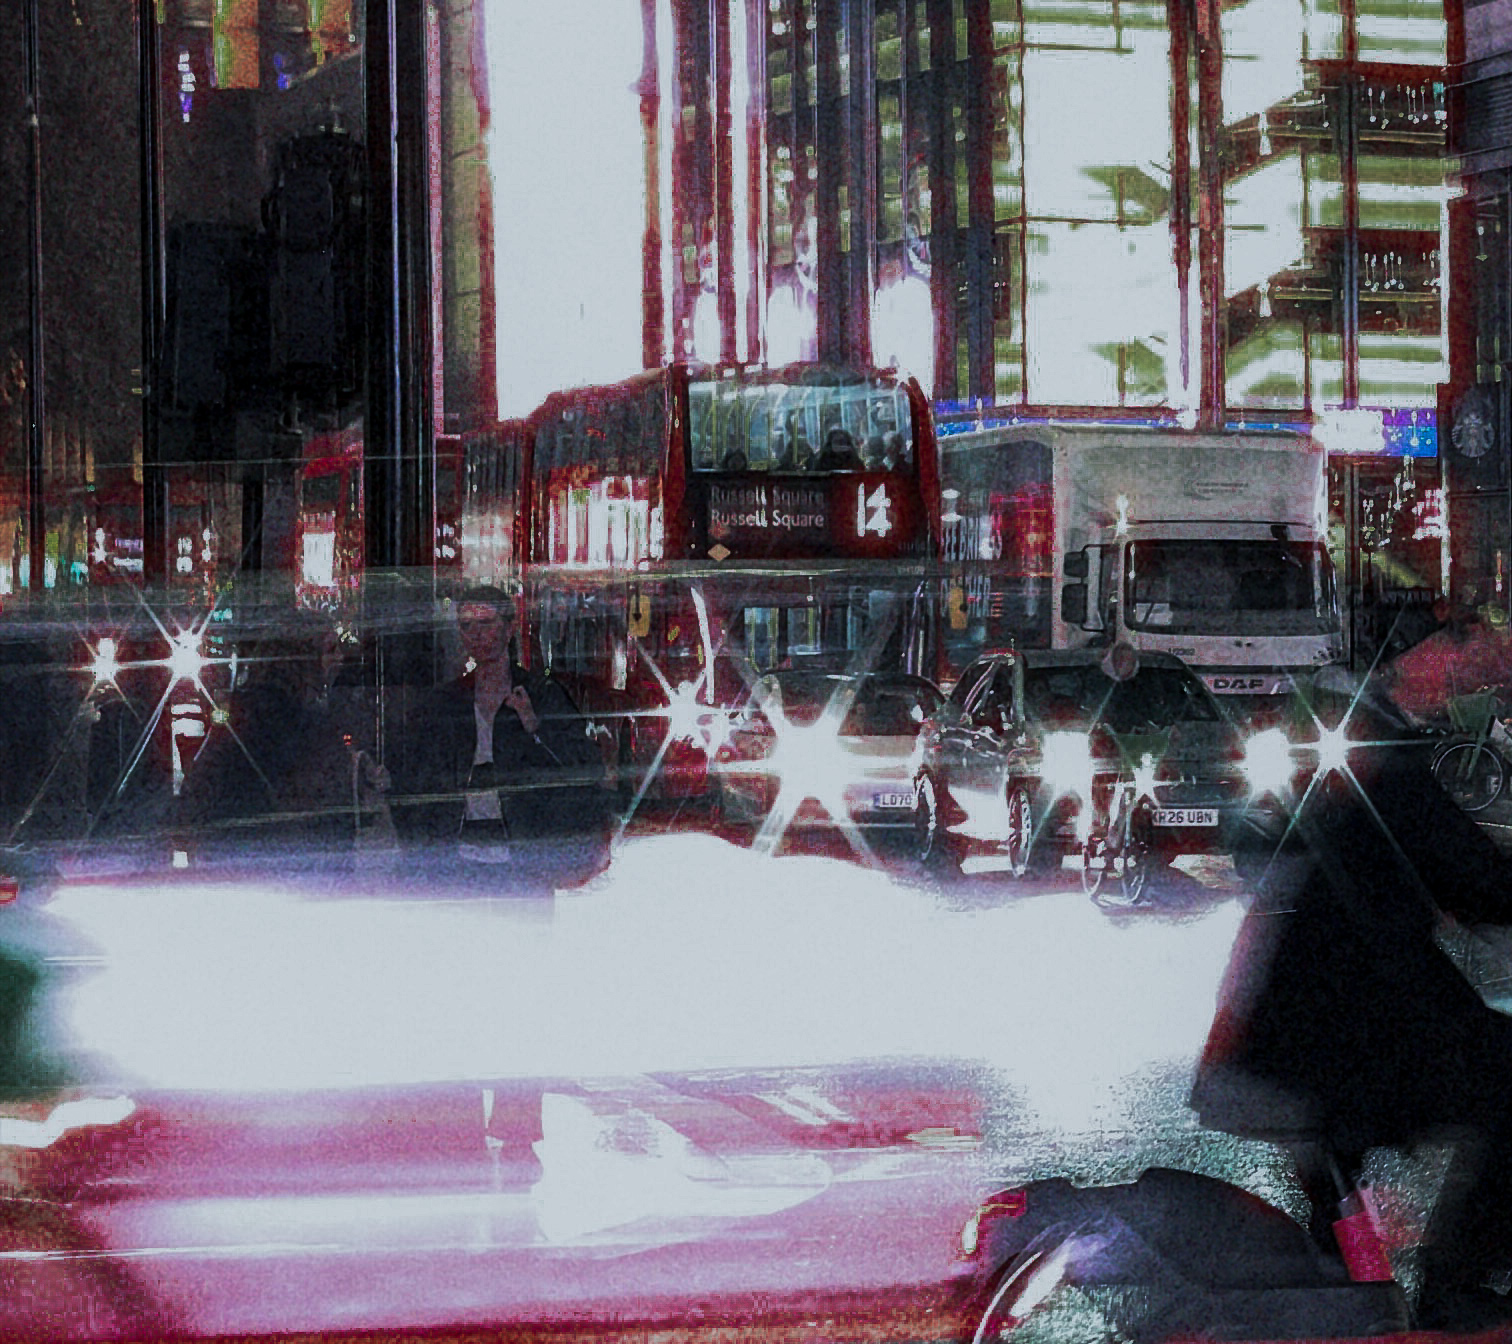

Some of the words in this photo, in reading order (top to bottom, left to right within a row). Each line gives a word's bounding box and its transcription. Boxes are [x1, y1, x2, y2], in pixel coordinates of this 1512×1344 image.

[710, 508, 769, 528] Russell
[771, 509, 826, 531] Square
[1213, 678, 1264, 690] DAF
